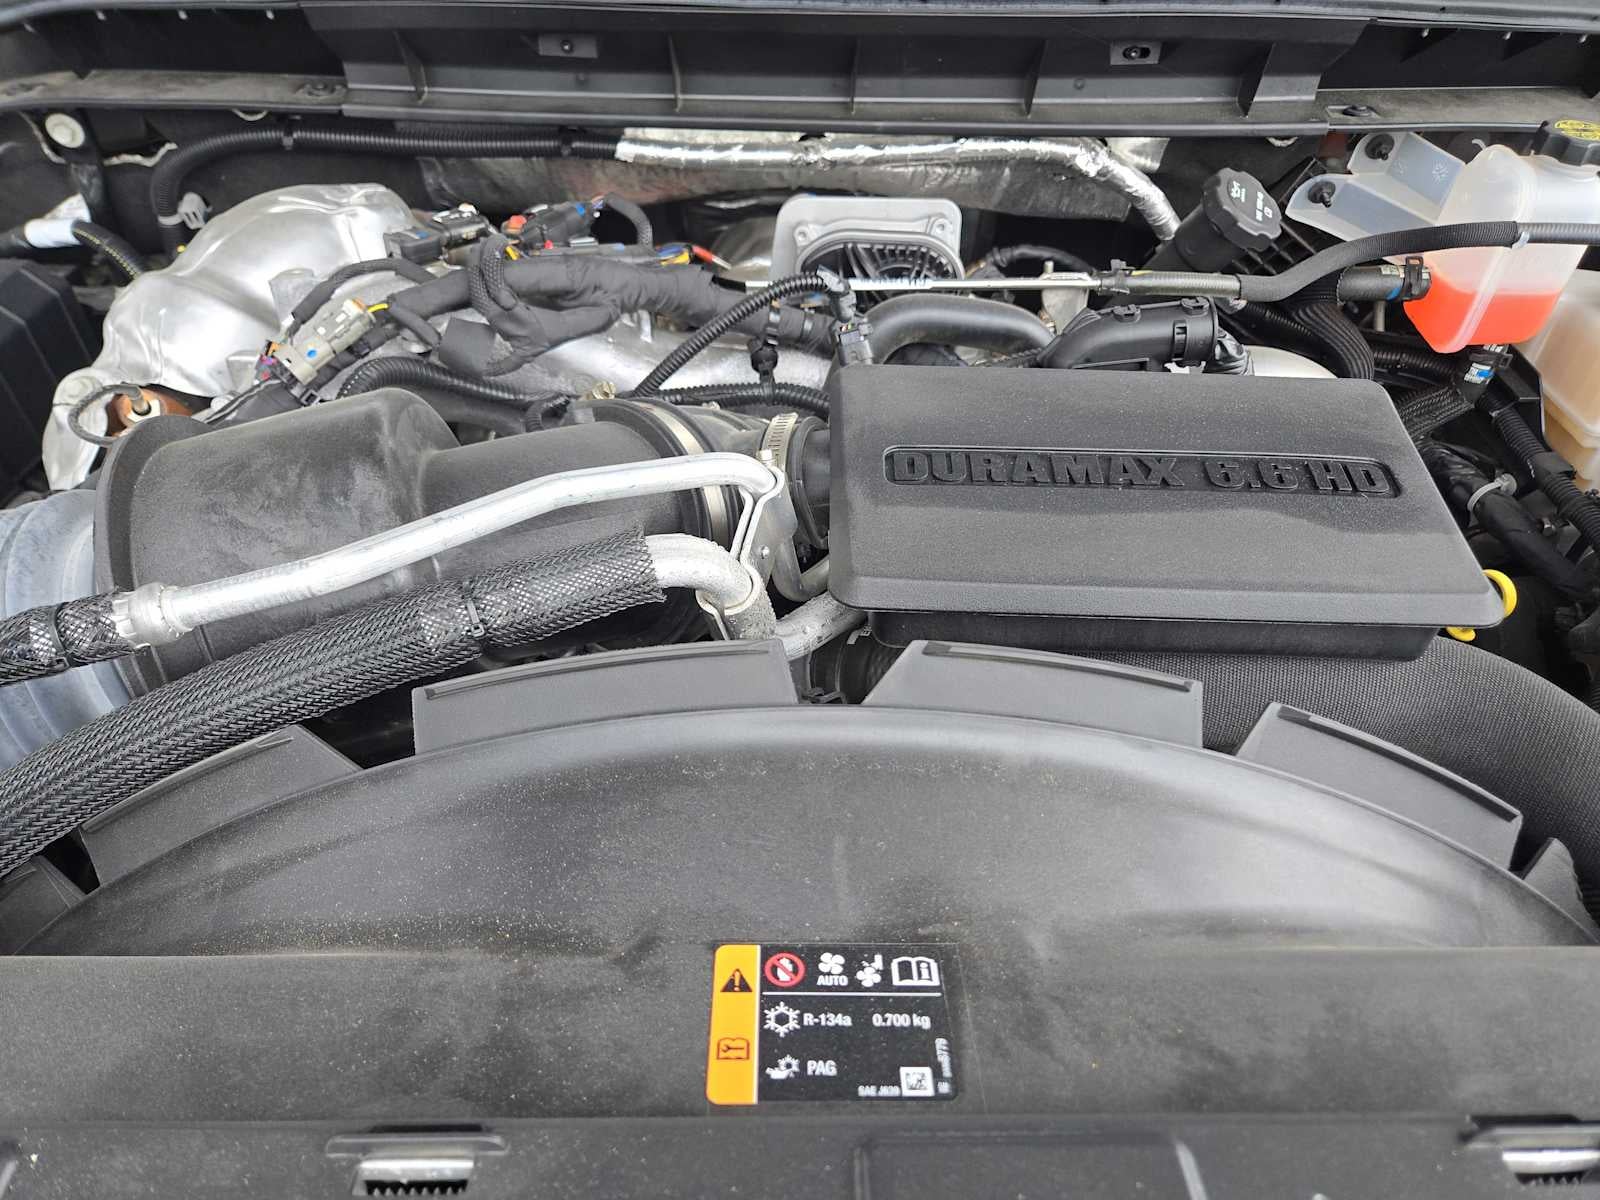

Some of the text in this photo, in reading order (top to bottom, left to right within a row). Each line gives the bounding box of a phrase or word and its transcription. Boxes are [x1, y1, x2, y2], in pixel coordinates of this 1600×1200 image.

[893, 452, 1391, 494] DURAMAX 6.6 HD
[817, 975, 848, 986] AUTO
[803, 1013, 931, 1030] R-134a 0.700 kg
[807, 1060, 837, 1076] PAG
